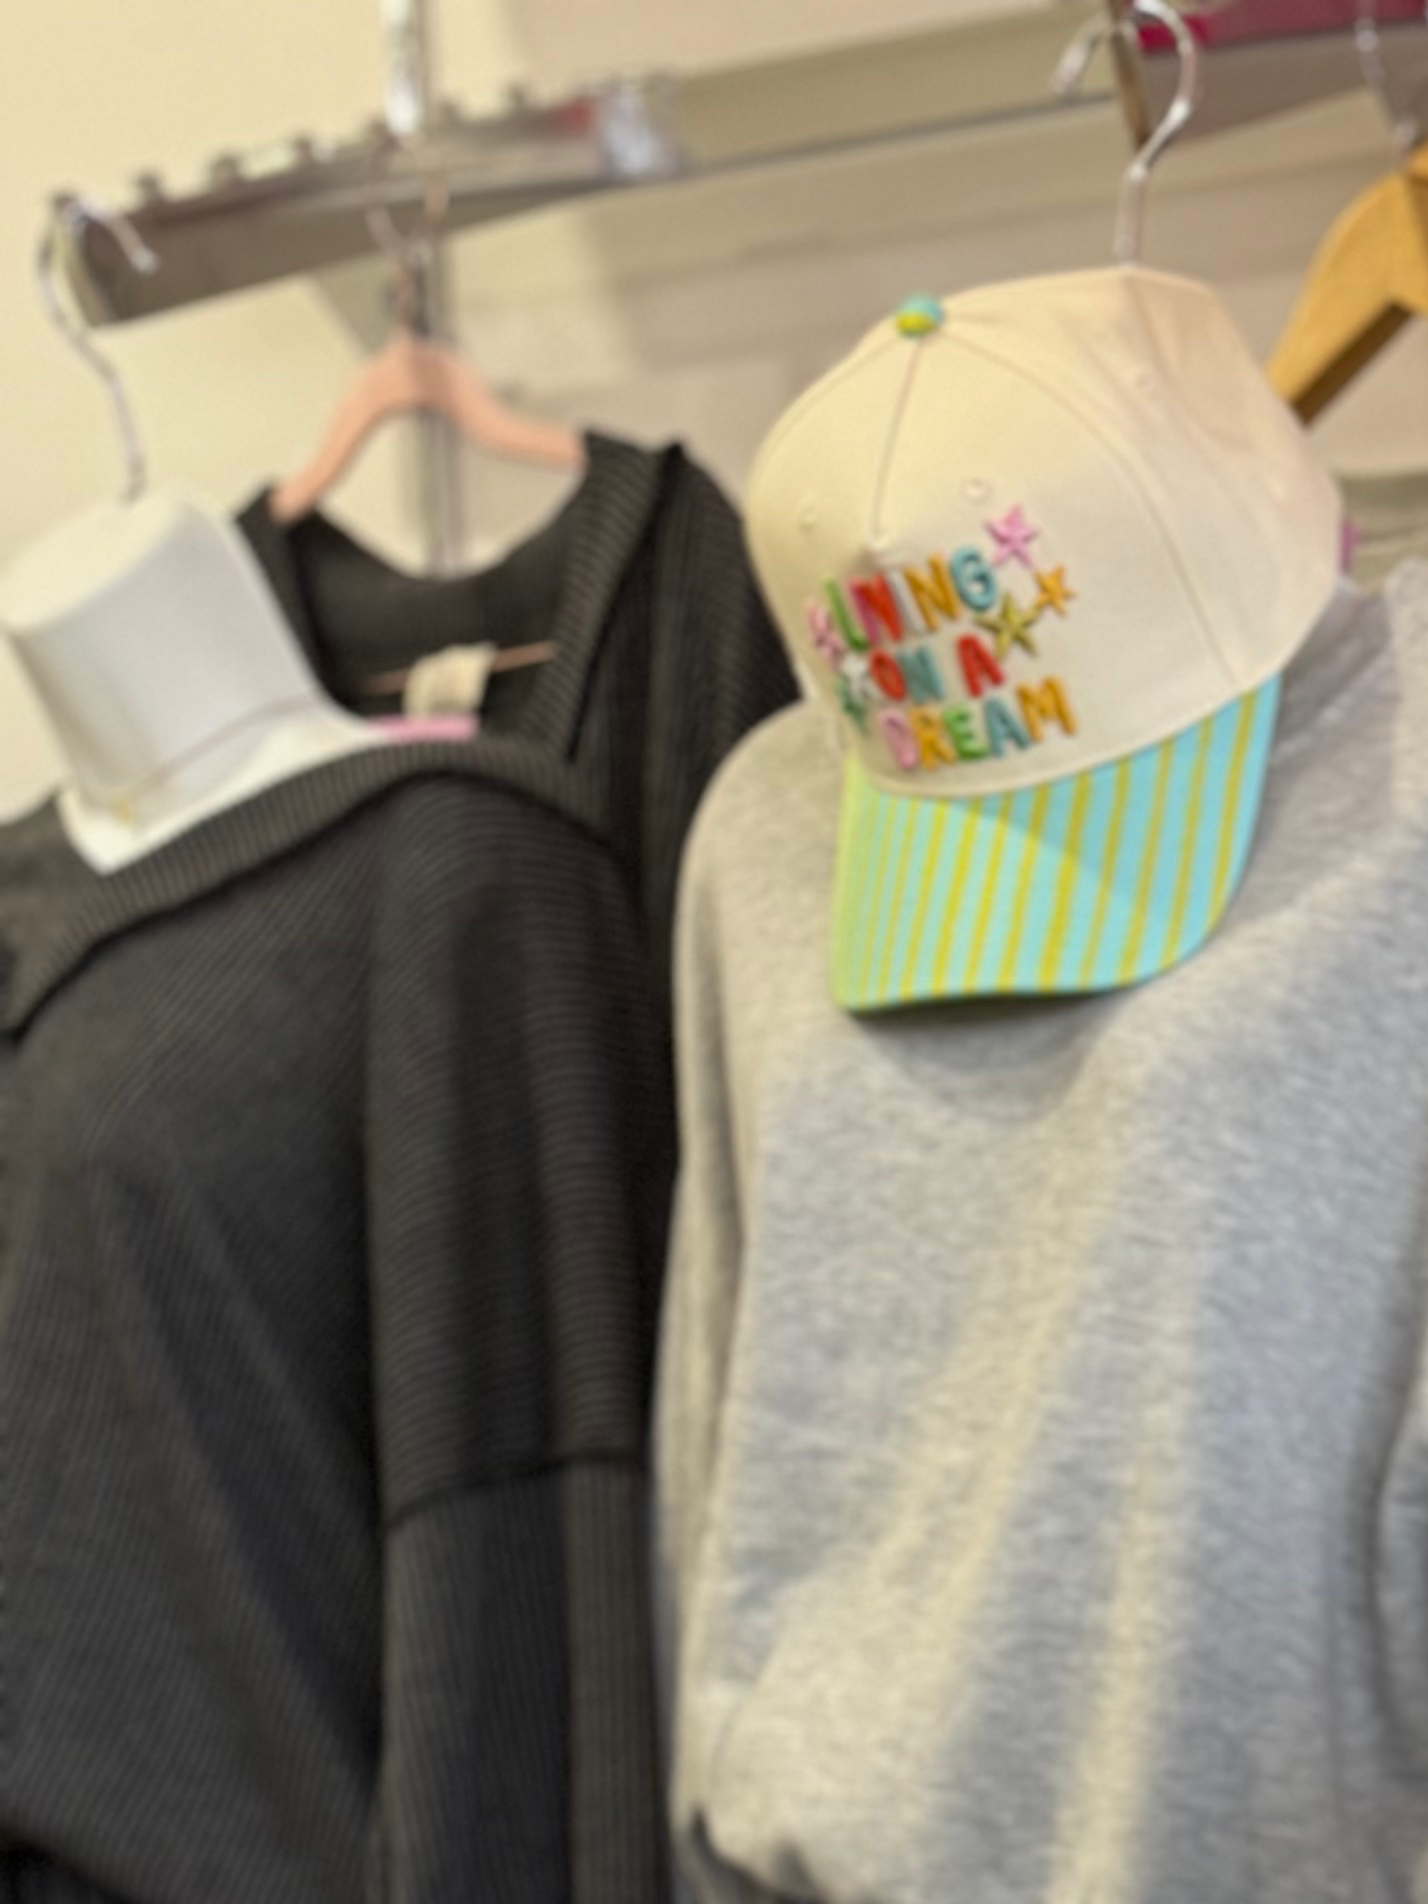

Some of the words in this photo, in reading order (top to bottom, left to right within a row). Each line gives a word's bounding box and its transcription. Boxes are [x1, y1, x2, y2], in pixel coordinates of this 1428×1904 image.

[869, 646, 943, 703] ON
[956, 634, 1005, 700] A
[881, 676, 1078, 770] DREAM
